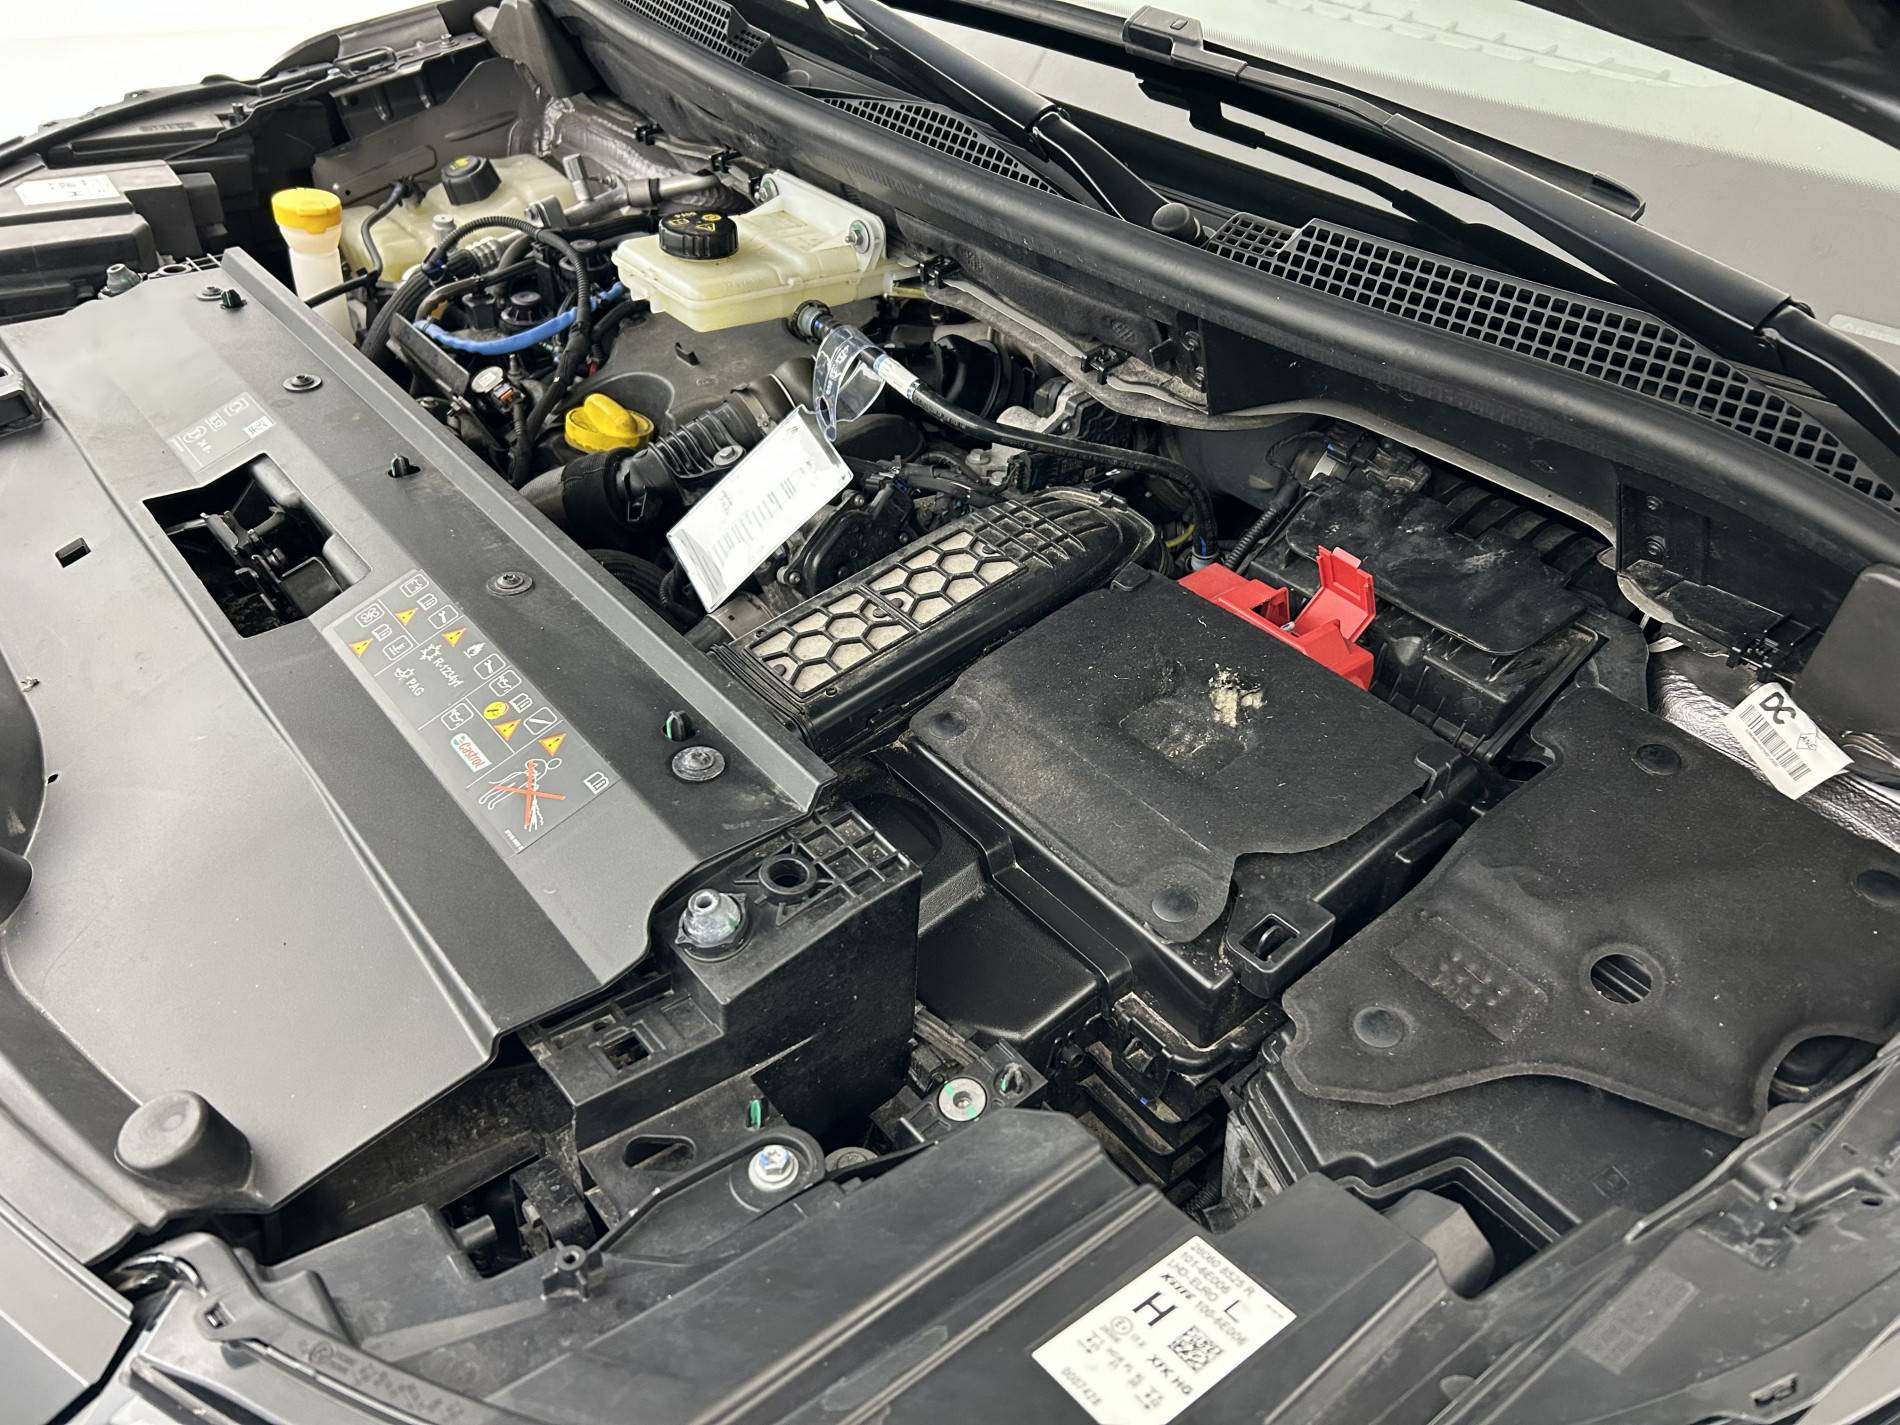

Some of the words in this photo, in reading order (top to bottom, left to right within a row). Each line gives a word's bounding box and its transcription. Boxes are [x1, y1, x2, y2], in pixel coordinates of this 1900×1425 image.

[432, 657, 464, 687] R-1234yf
[406, 678, 425, 696] PAG
[1759, 691, 1796, 725] DC
[458, 741, 486, 769] Castrol
[1242, 1285, 1256, 1296] R
[1132, 1291, 1177, 1327] H
[1223, 1299, 1240, 1323] L
